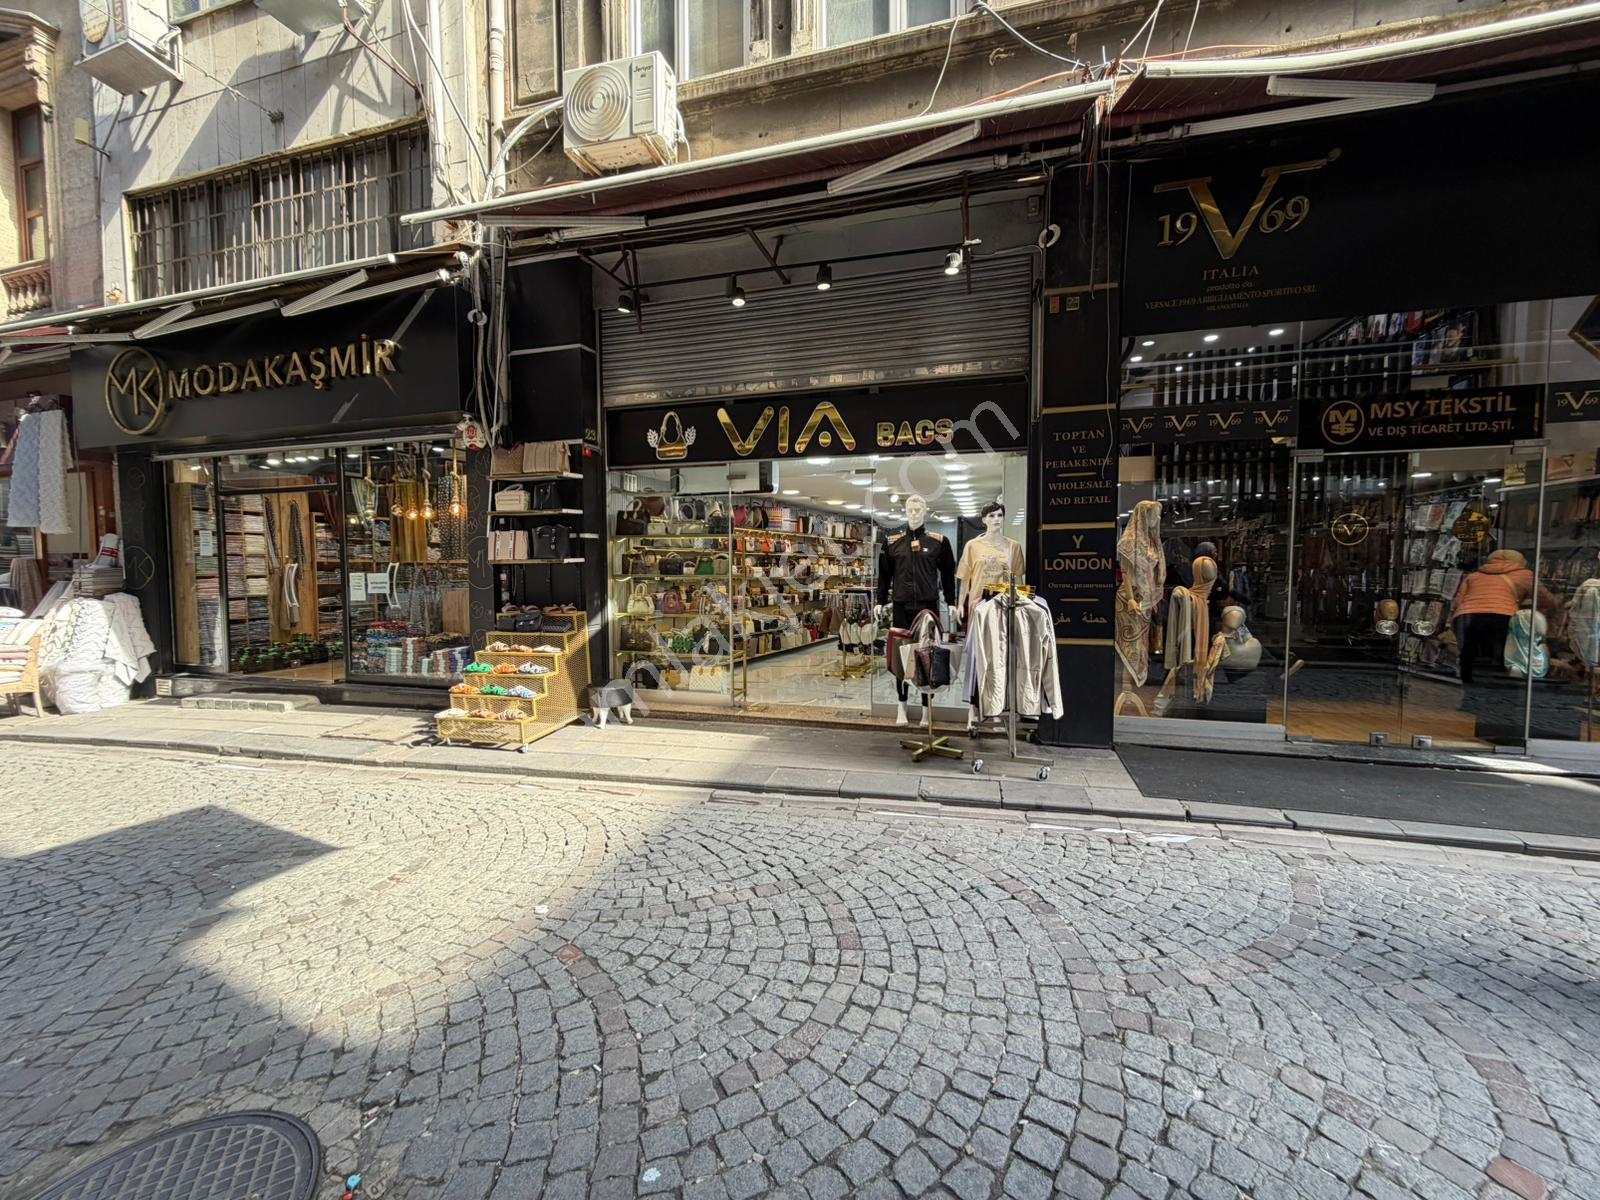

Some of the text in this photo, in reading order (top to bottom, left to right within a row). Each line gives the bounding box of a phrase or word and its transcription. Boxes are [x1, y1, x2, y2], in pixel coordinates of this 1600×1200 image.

[1202, 265, 1260, 281] ITALIA
[168, 333, 398, 399] MODAKAŞMİR
[1370, 391, 1518, 419] MSY TEKSTİL
[717, 401, 954, 456] VIA BAGS
[1053, 429, 1105, 441] TOPTAN
[1368, 426, 1385, 438] VE
[1387, 425, 1408, 438] DIŞ
[1409, 419, 1463, 435] TİCARET
[1072, 445, 1087, 454] VE
[1045, 457, 1114, 469] PERAKENDE
[1048, 480, 1112, 491] WHOLESALE
[1049, 495, 1112, 506] AND RETAIL
[1072, 534, 1085, 549] Y
[1044, 557, 1113, 571] LONDON
